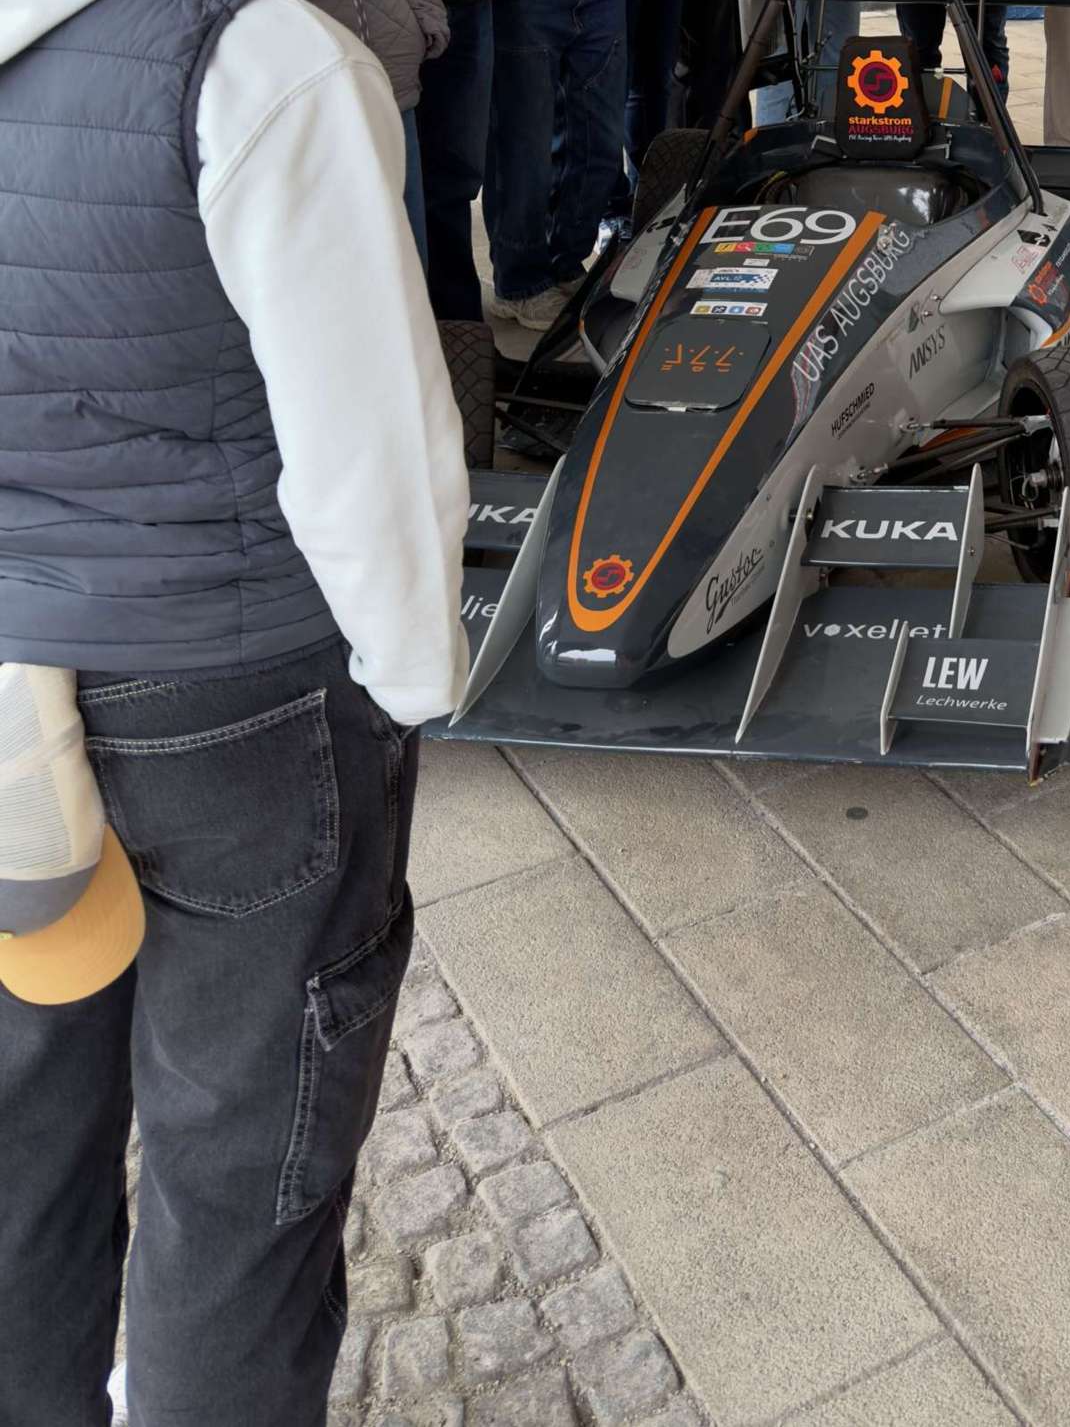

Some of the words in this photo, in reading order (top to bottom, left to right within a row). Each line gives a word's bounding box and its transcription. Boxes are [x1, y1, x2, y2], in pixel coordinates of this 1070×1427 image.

[848, 116, 912, 125] starkstrom
[848, 125, 914, 135] AUGSBURG
[700, 206, 857, 245] E69
[793, 324, 839, 381] UAS
[830, 229, 910, 337] AUGSBURG
[821, 519, 958, 541] KUKA
[803, 618, 947, 639] voxelet
[922, 656, 989, 690] LEW
[916, 694, 1008, 711] Lechwerke
